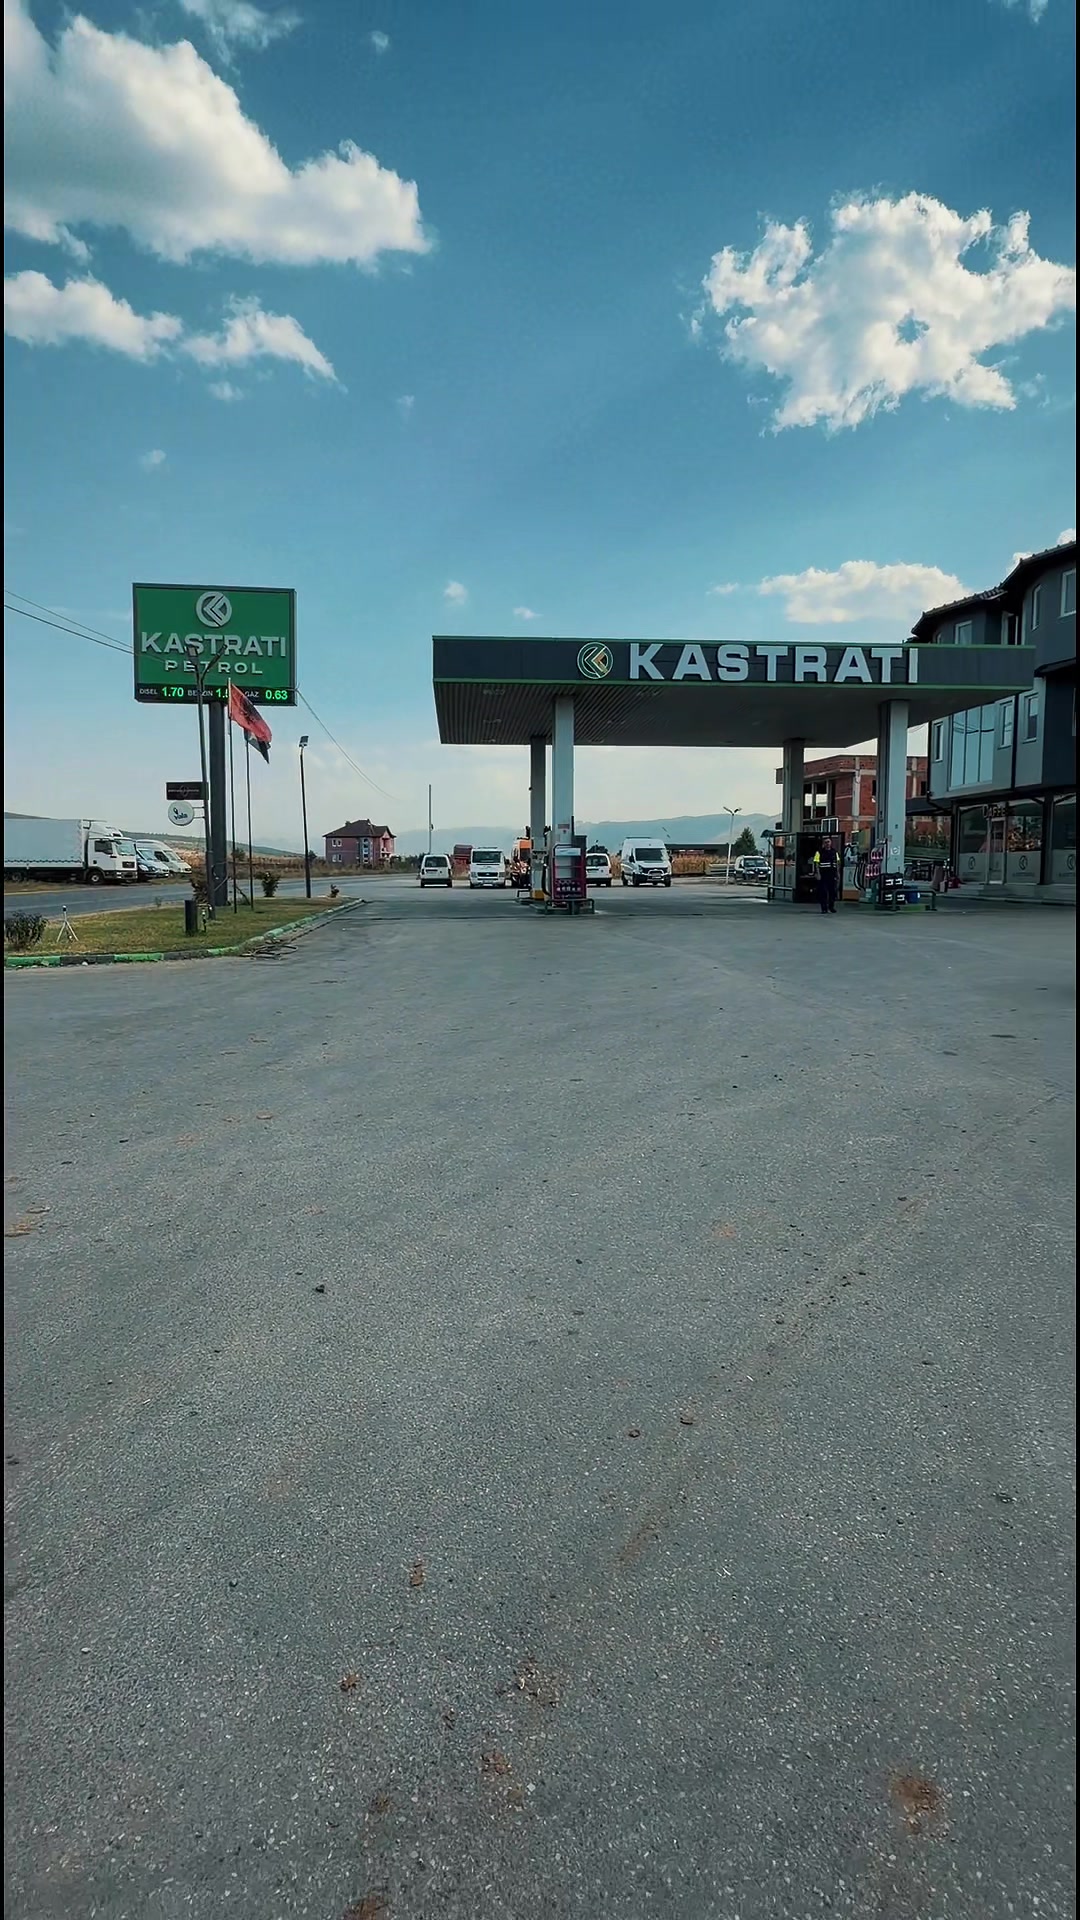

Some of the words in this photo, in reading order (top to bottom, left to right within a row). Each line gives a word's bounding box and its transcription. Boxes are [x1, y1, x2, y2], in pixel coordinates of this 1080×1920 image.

[141, 631, 286, 657] KASTRATI
[164, 660, 263, 674] PETROL
[629, 643, 918, 683] KASTRATI
[162, 686, 184, 697] 1.70
[187, 689, 214, 697] BEZIN
[265, 689, 288, 700] 0.63
